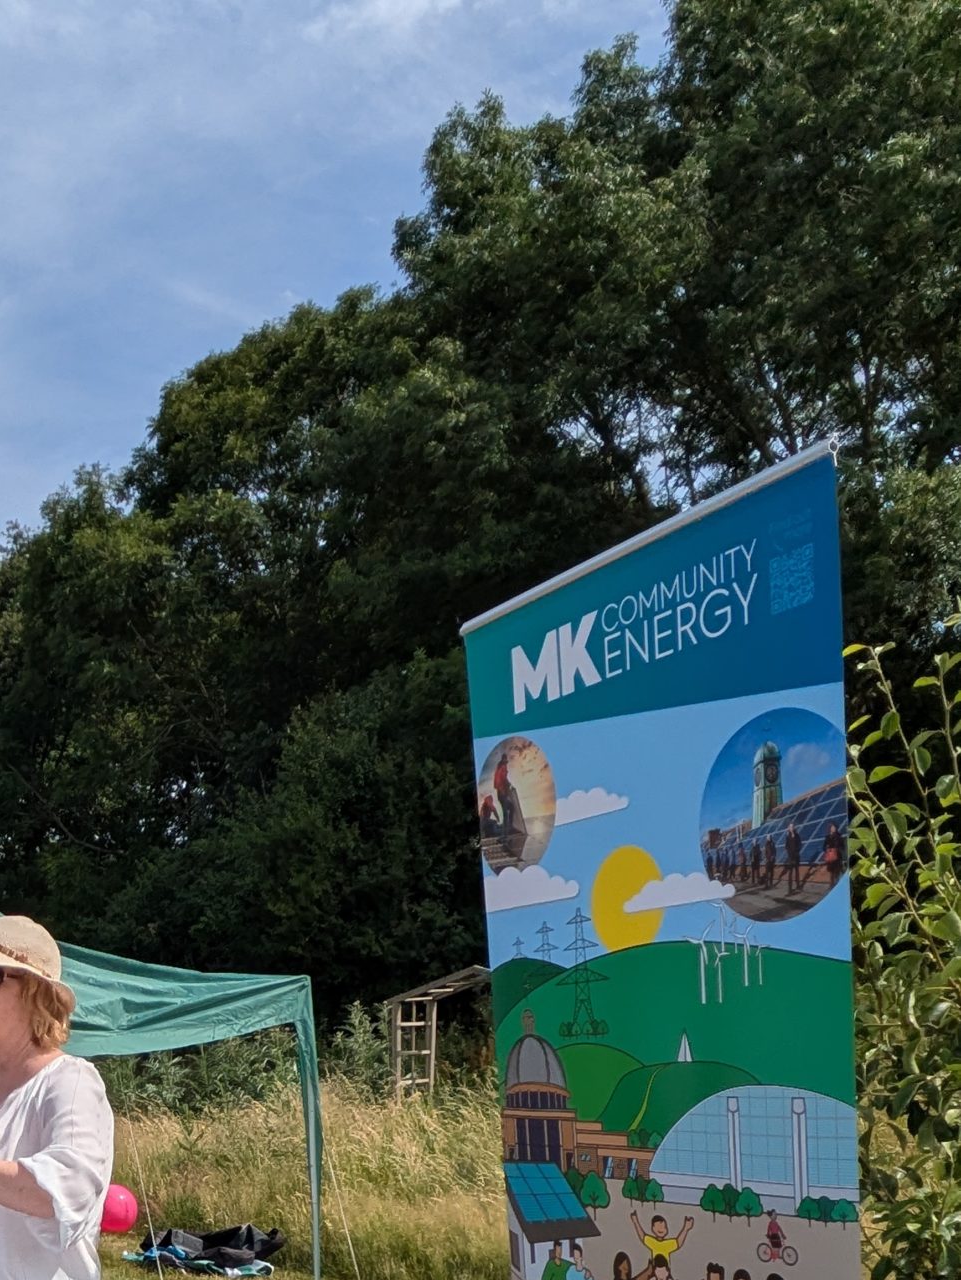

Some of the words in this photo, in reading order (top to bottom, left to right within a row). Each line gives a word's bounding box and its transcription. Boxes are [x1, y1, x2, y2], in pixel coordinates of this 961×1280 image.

[511, 610, 602, 715] MK
[601, 538, 757, 633] COMMUNITY
[603, 572, 758, 678] ENERGY
